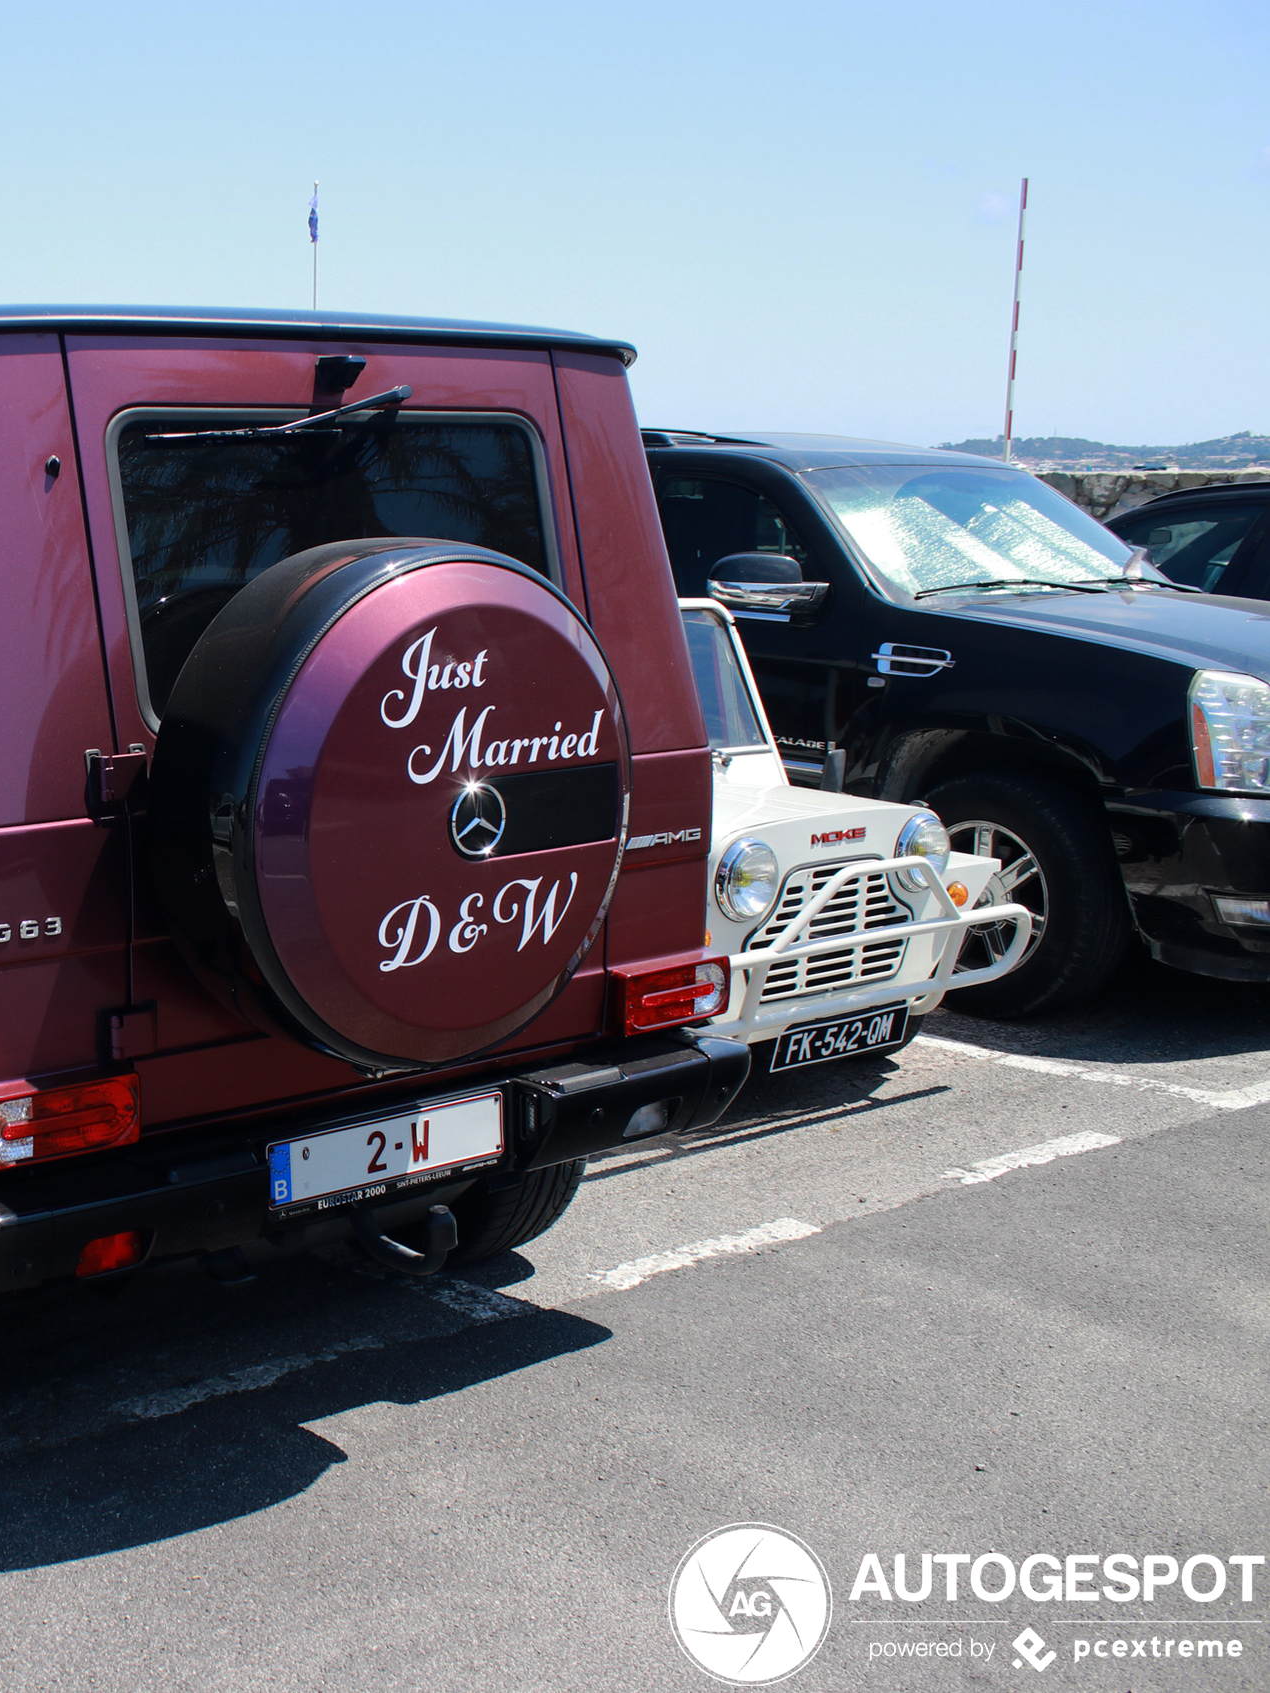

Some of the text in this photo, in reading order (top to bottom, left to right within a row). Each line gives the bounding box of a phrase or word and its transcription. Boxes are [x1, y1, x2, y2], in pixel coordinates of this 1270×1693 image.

[380, 626, 489, 729] Just
[407, 705, 605, 785] Married
[647, 827, 702, 847] AMG
[811, 826, 867, 845] MOKE
[377, 871, 578, 972] D&W
[785, 1012, 895, 1064] FK-542-QM
[274, 1179, 289, 1201] B
[317, 1184, 387, 1211] EUROSTAR 2000
